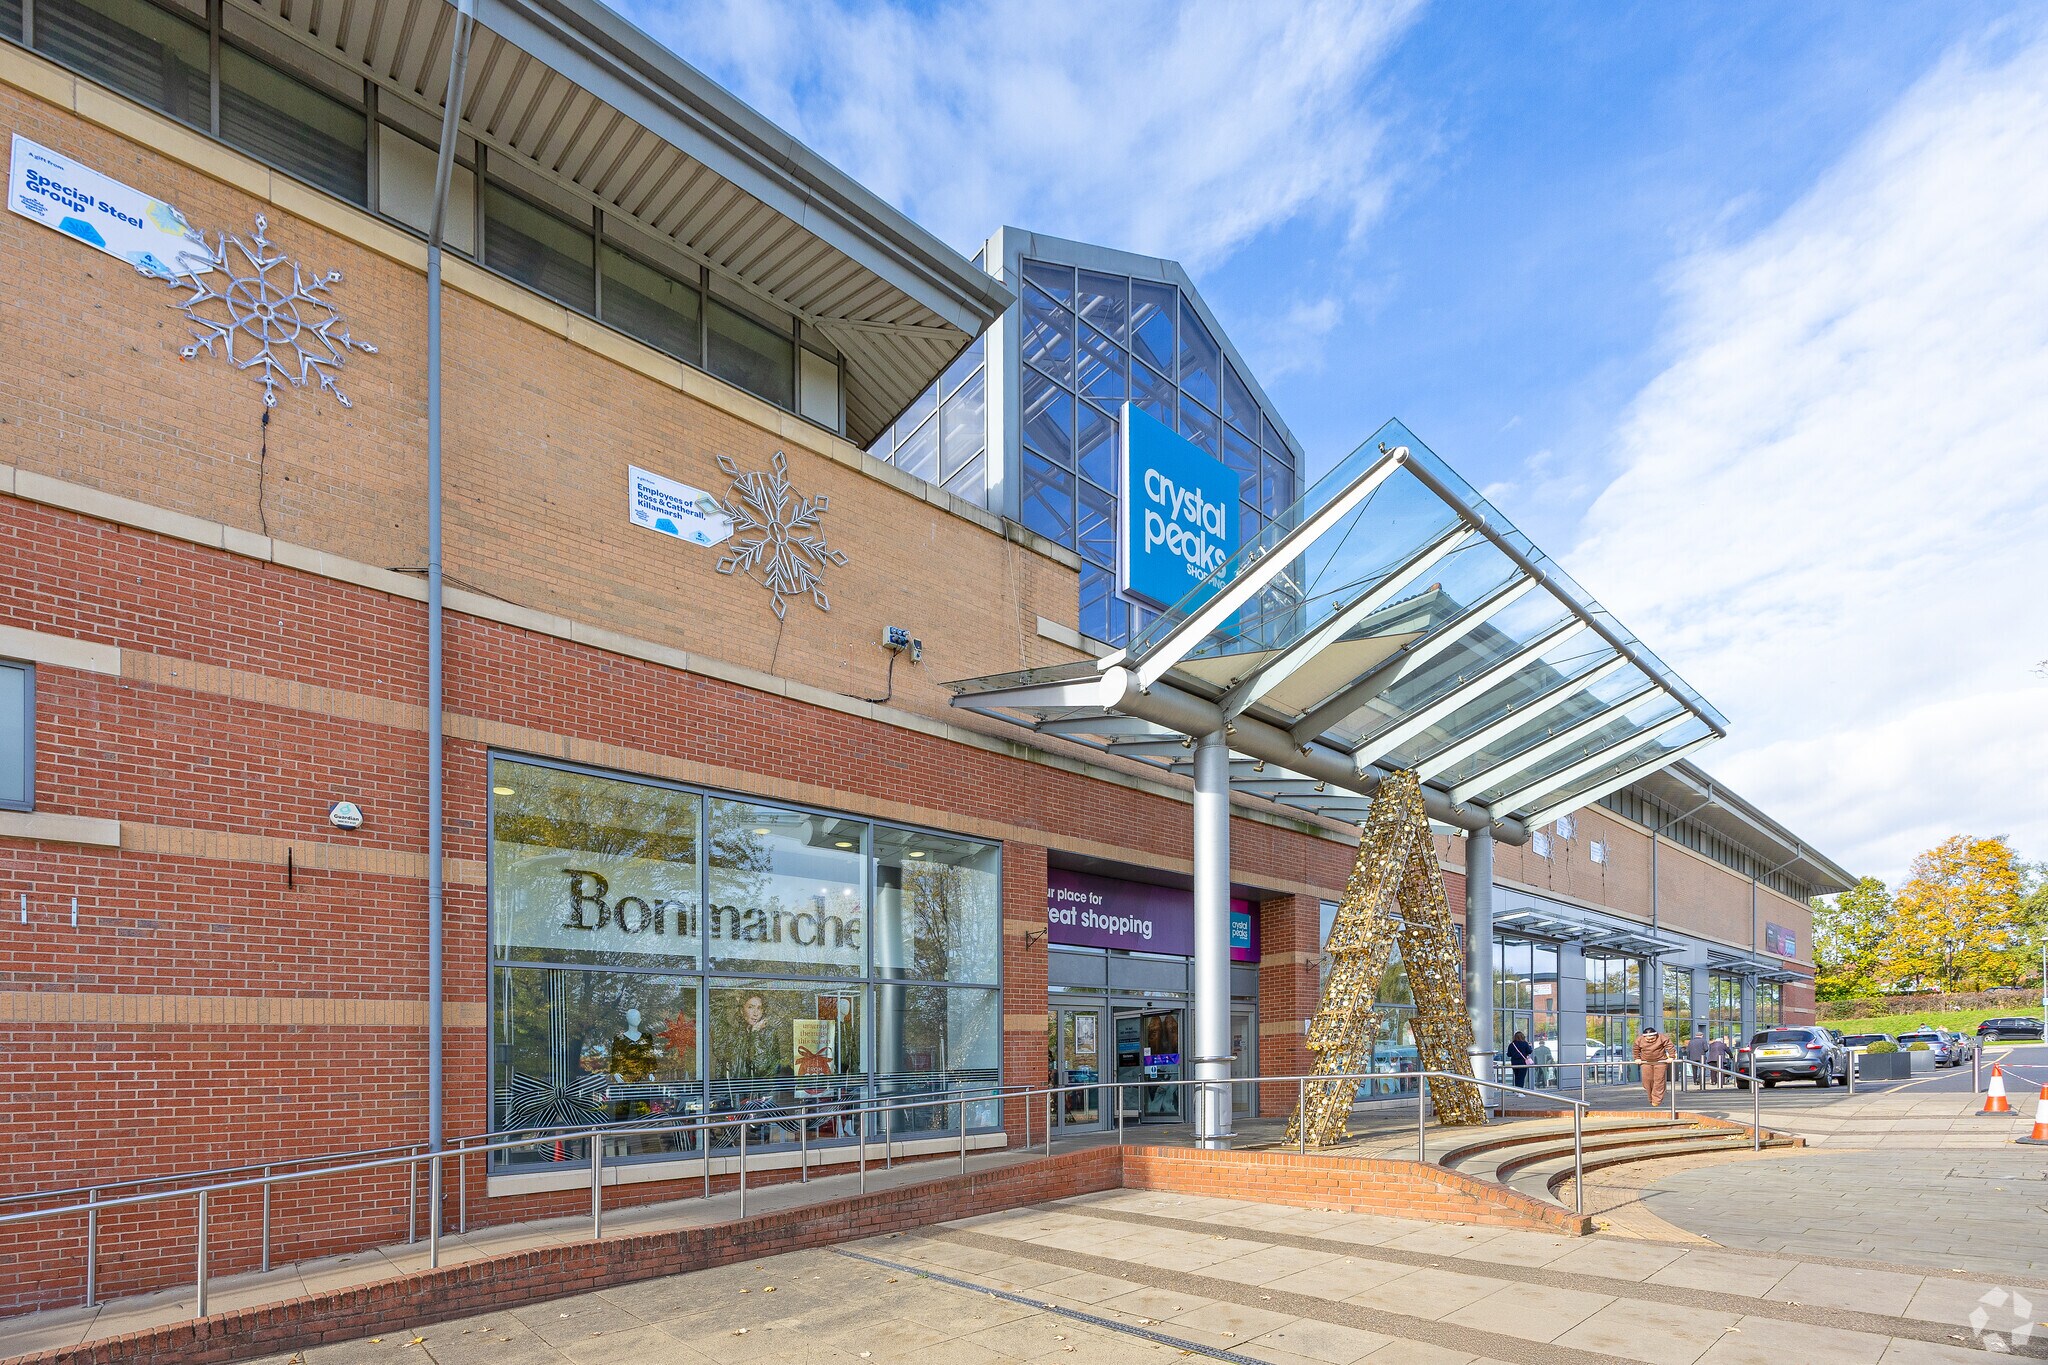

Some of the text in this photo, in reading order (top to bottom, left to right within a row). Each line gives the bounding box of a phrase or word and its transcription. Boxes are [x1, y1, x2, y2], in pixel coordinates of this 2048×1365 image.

[26, 180, 85, 213] Group
[26, 169, 94, 207] Special
[98, 201, 143, 229] Steel
[144, 254, 153, 262] 4
[637, 483, 694, 508] Employees of
[637, 491, 706, 521] Ross & Catherall,
[1144, 468, 1226, 541] crystal
[637, 499, 683, 520] Killamarsh
[1144, 508, 1227, 579] peaks
[1057, 888, 1087, 903] place
[1089, 892, 1103, 905] for
[1047, 906, 1153, 940] eat shopping
[1232, 921, 1248, 930] crystal
[1232, 930, 1248, 938] peaks
